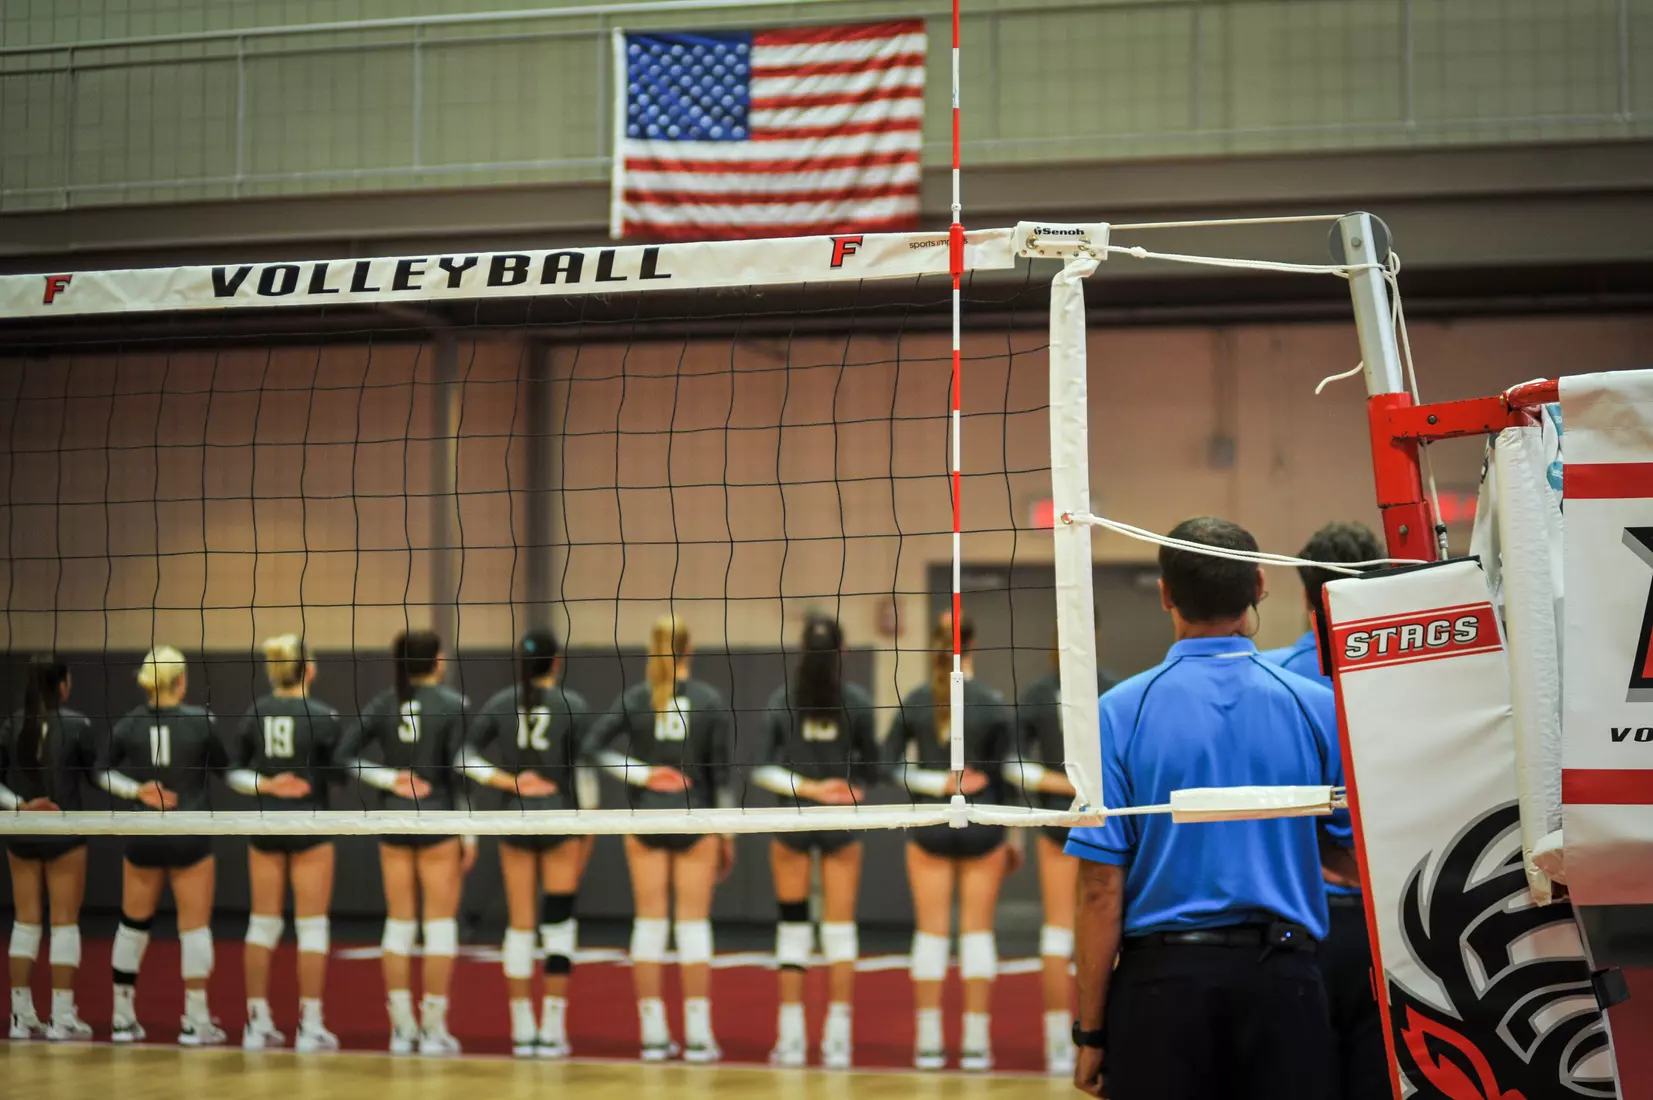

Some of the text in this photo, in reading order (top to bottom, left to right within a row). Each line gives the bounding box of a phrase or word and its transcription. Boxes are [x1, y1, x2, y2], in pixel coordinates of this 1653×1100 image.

[909, 239, 936, 249] sports
[1042, 227, 1085, 235] Senoh
[211, 247, 672, 298] VOLLEYBALL
[829, 235, 863, 270] F
[43, 274, 73, 305] F
[1345, 615, 1479, 660] STAGS
[150, 725, 171, 766] 11
[264, 716, 295, 758] 19
[517, 705, 550, 750] 12
